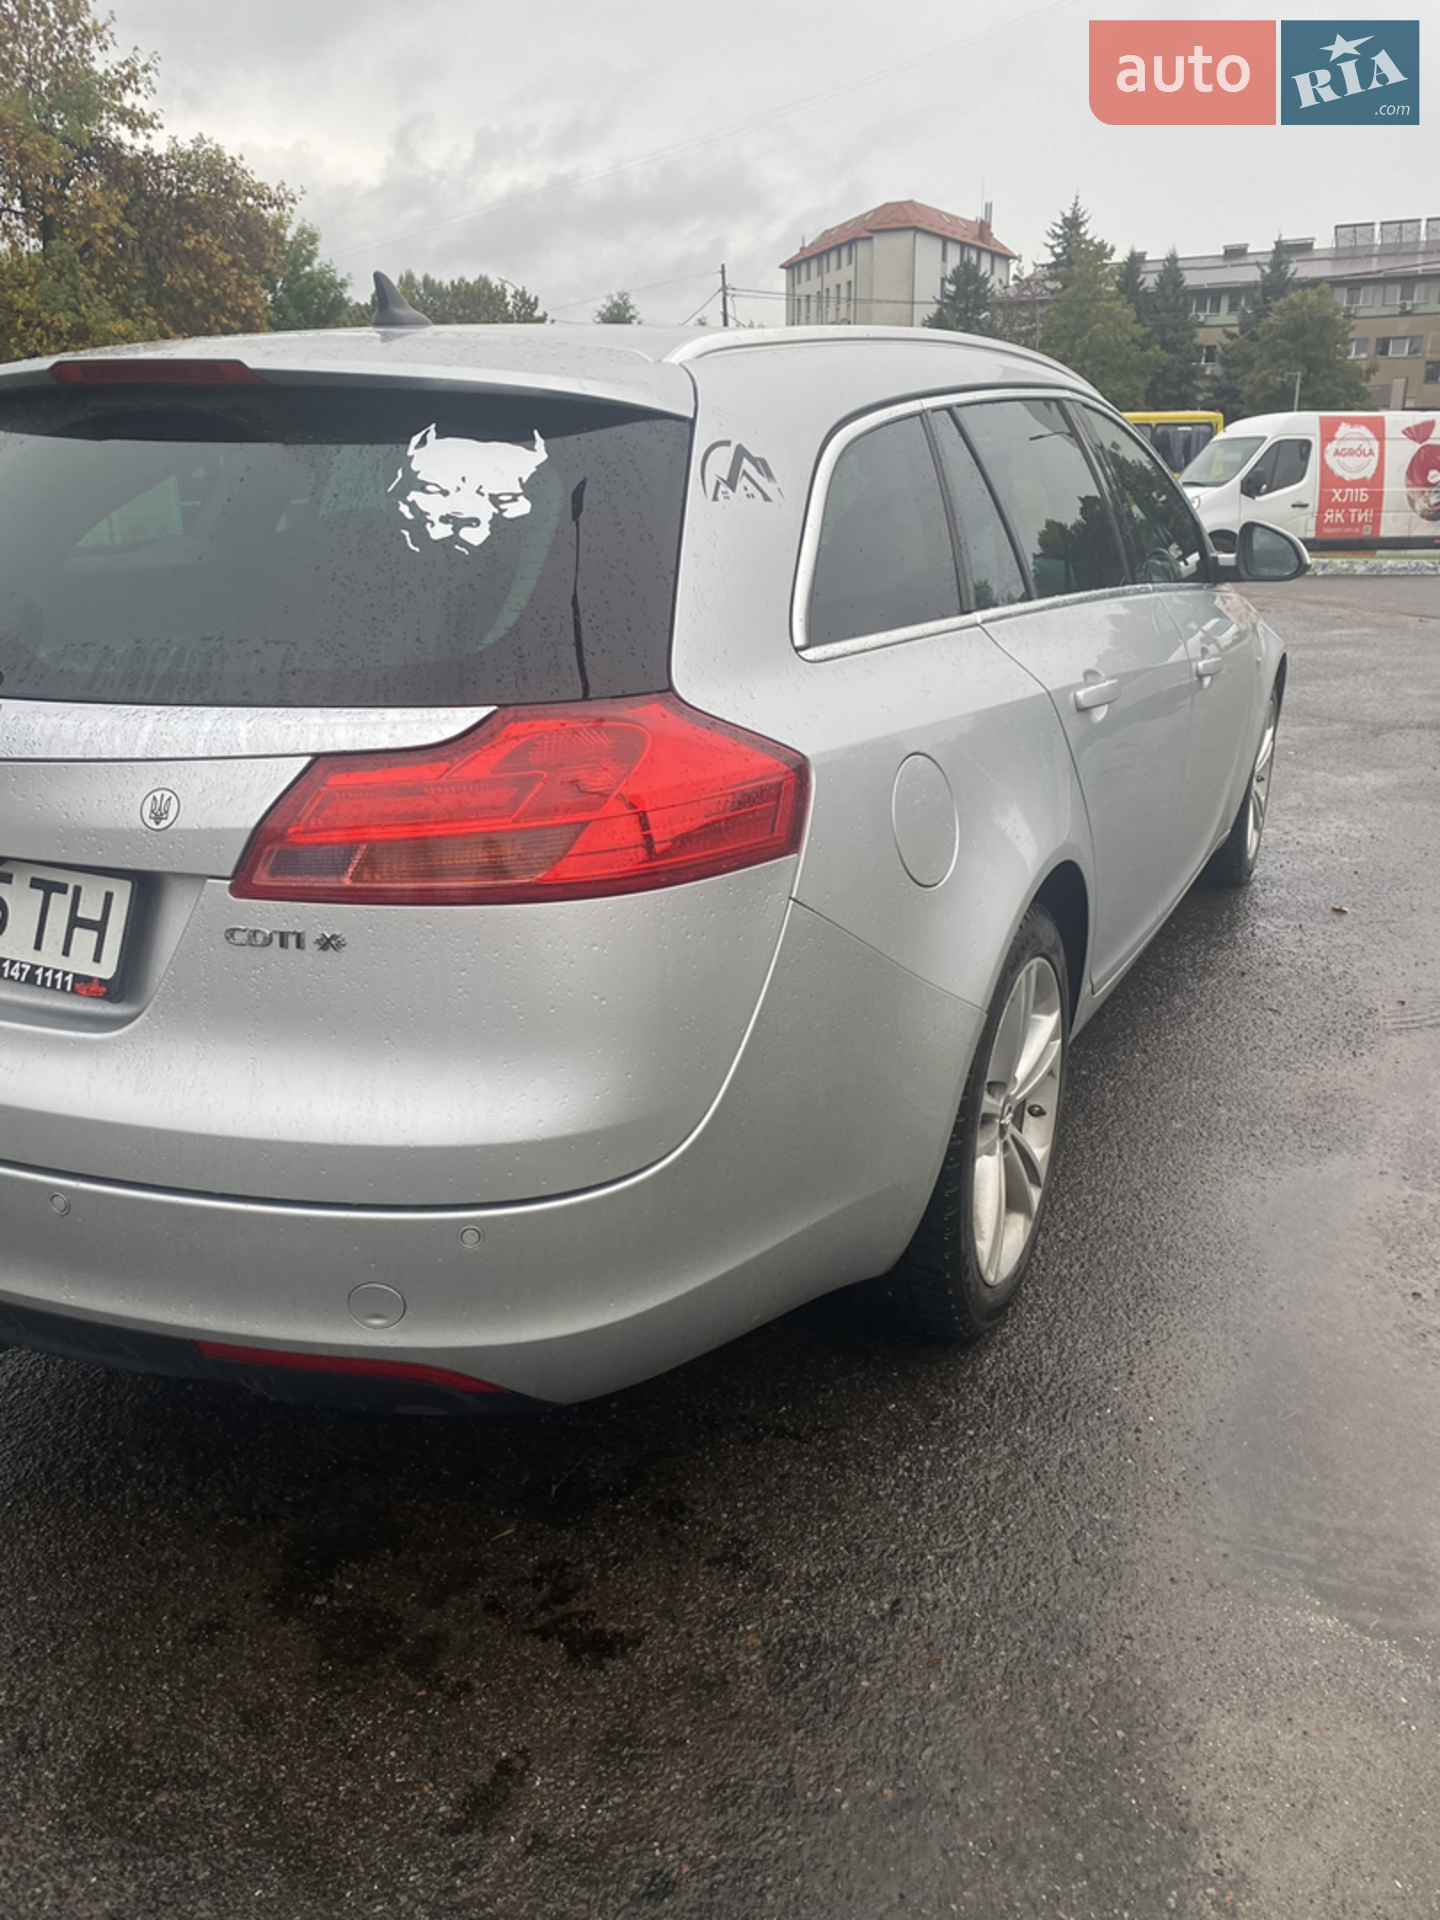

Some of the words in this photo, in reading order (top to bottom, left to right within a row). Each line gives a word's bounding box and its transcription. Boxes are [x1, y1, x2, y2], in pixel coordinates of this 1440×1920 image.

[1331, 488, 1369, 502] ХЛІБ
[1324, 508, 1345, 523] ЯК
[1349, 508, 1373, 523] ТИ!
[29, 876, 114, 964] TH
[223, 926, 305, 950] CDTI
[2, 959, 31, 982] 147
[35, 967, 73, 992] 1111
